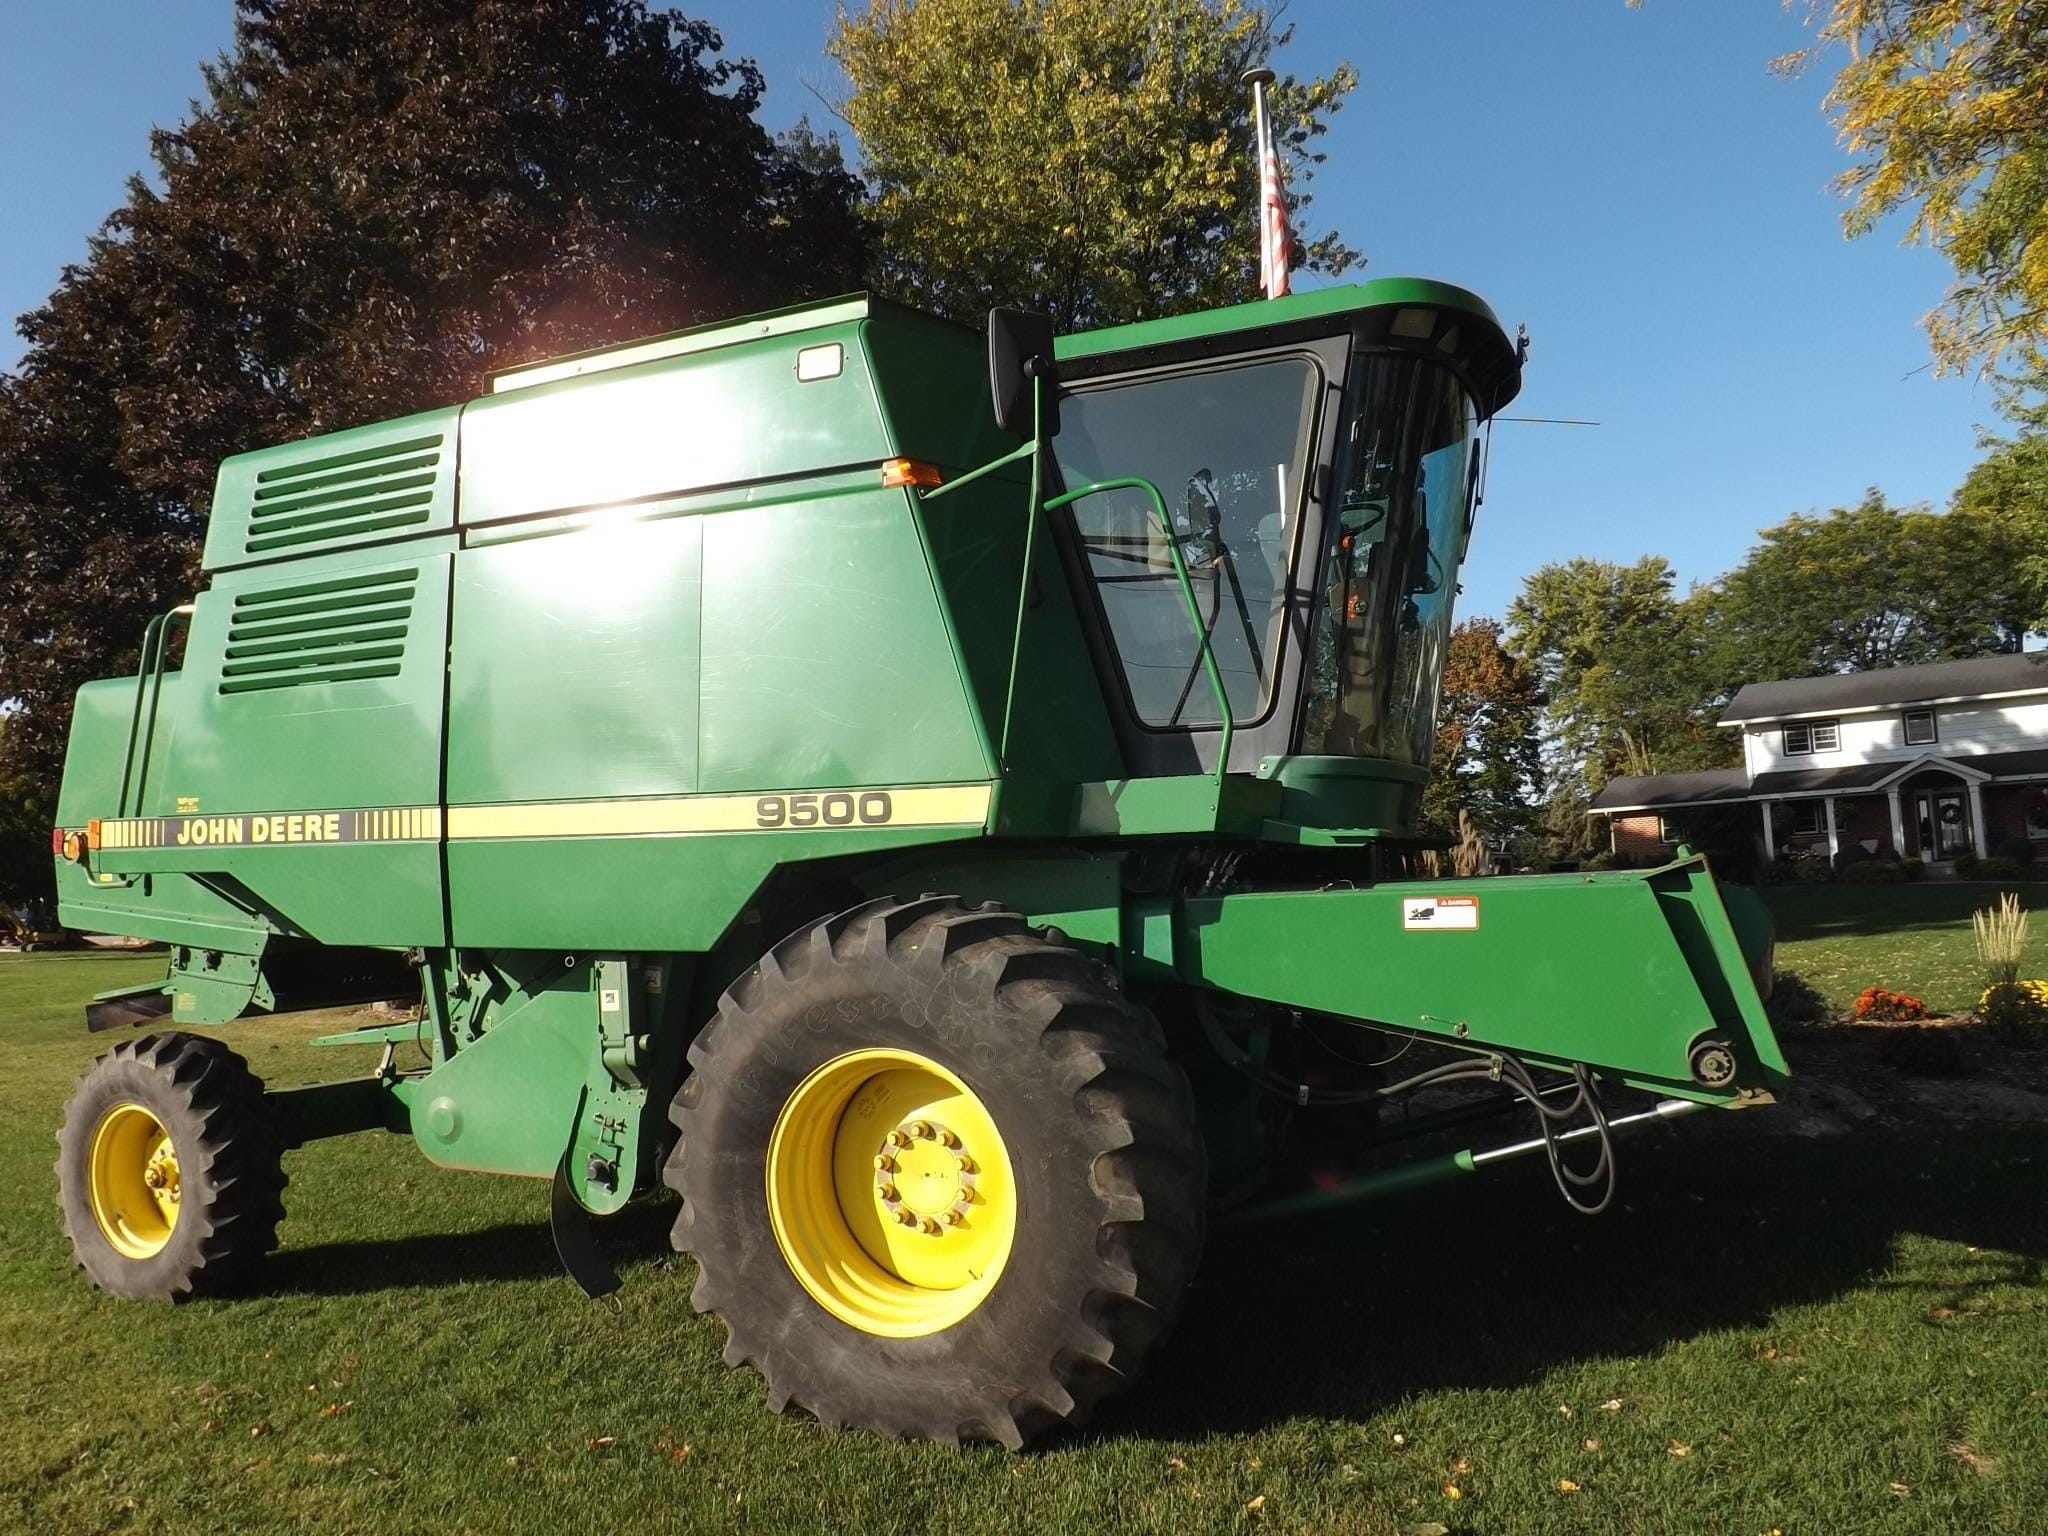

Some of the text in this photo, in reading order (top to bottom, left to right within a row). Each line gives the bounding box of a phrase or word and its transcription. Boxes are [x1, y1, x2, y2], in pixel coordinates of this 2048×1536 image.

[756, 792, 892, 827] 9500
[177, 814, 340, 845] JOHN DEERE
